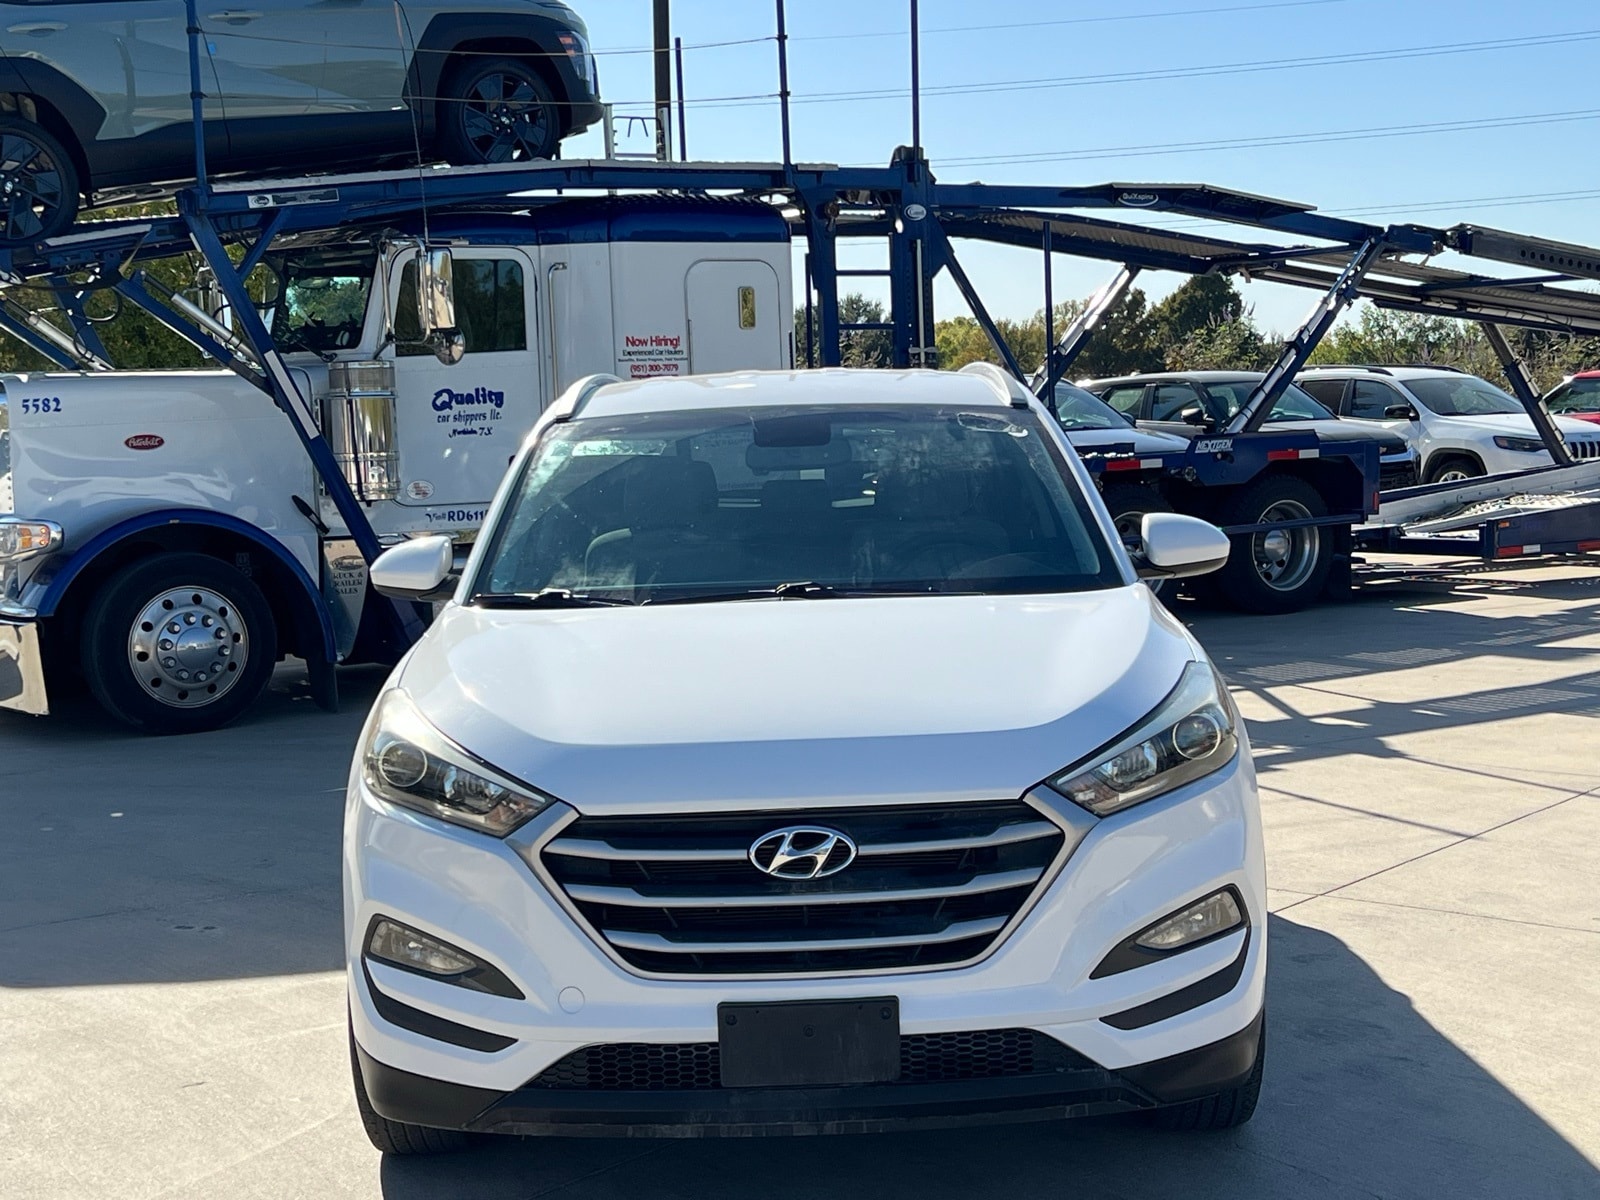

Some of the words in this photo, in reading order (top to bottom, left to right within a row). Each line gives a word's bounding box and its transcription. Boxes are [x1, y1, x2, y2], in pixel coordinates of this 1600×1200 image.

[625, 335, 649, 347] Now
[649, 335, 681, 349] Hiring!
[622, 349, 655, 357] Experienced
[655, 348, 665, 356] Car
[630, 363, 648, 374] (951)
[21, 397, 62, 414] 5582
[431, 387, 504, 411] Quality
[437, 414, 451, 423] car
[453, 410, 487, 426] shippers
[1195, 438, 1233, 453] NEXTGEN
[334, 579, 363, 587] RAILER
